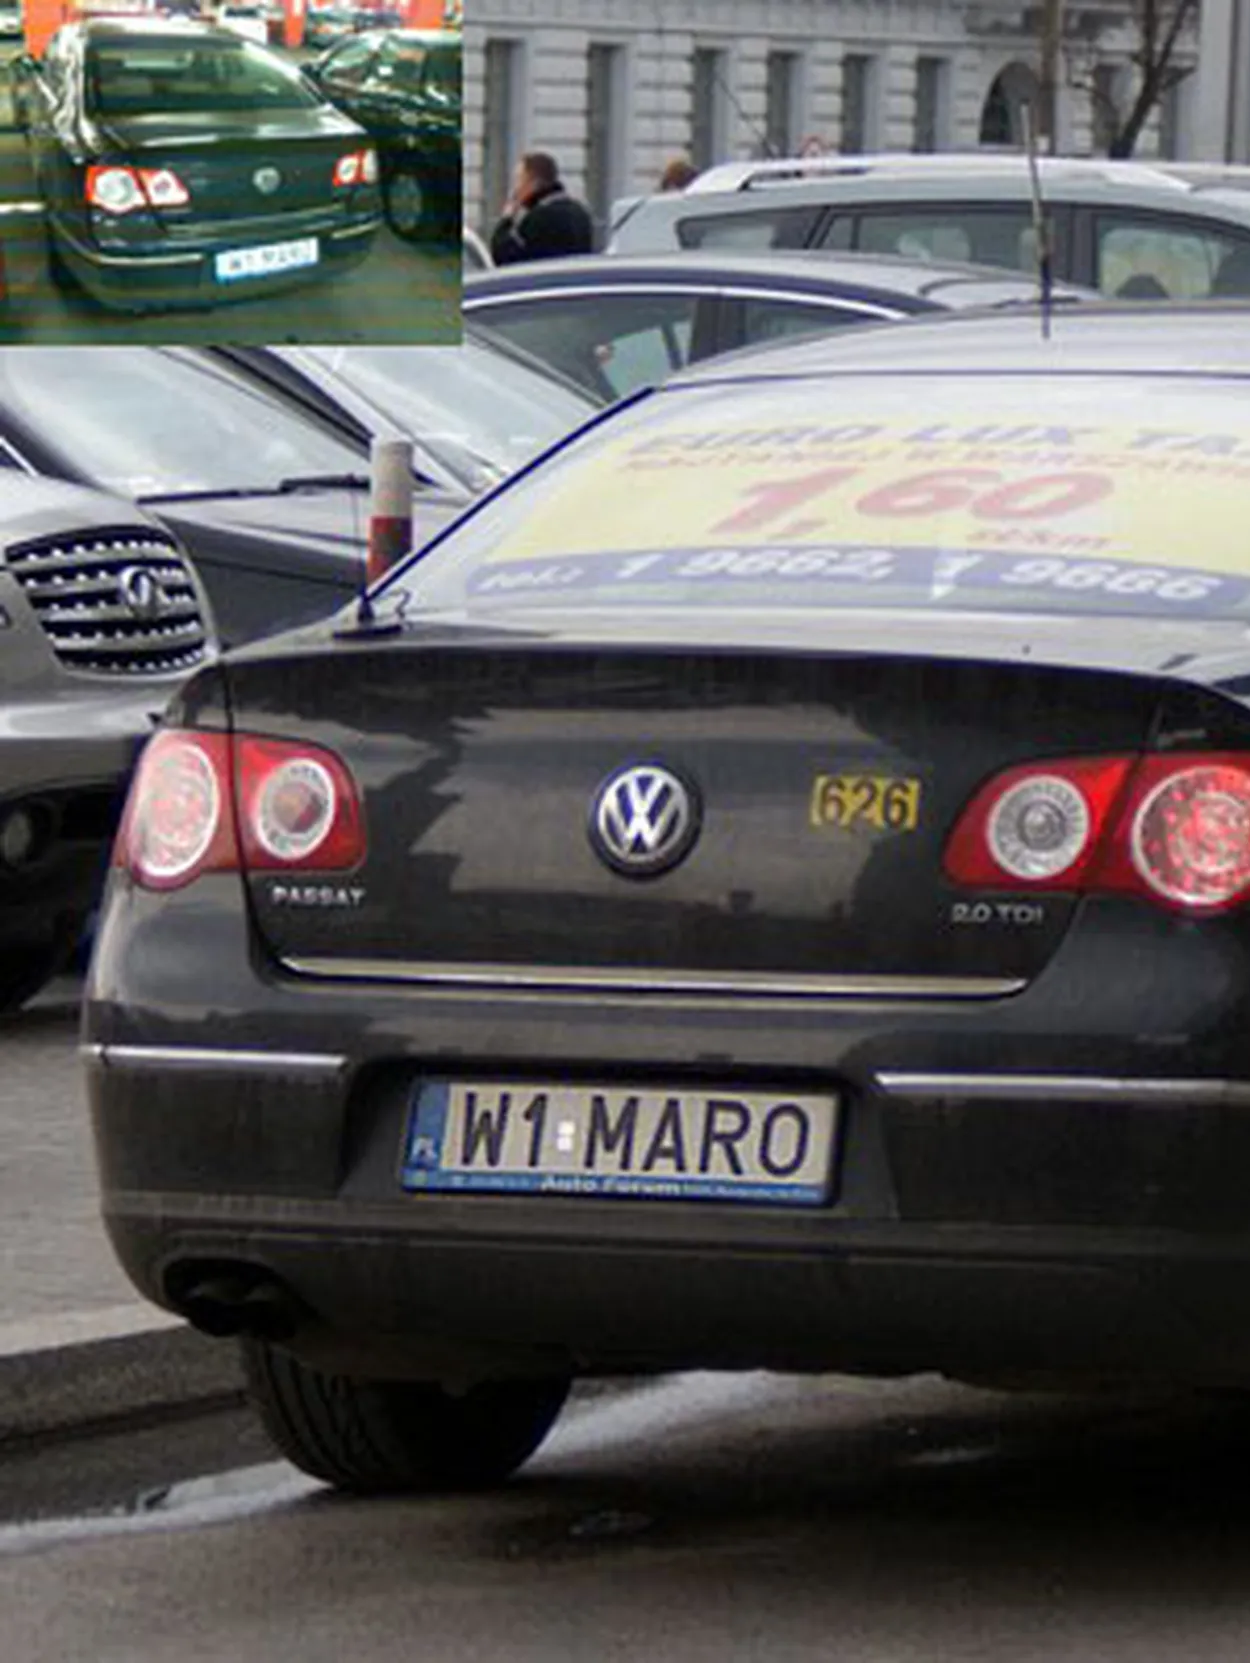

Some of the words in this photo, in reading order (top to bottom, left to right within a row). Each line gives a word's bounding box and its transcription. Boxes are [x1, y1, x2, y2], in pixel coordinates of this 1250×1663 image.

[629, 424, 886, 453] EURO
[902, 423, 1103, 445] LUX
[1001, 557, 1222, 600] 9666
[819, 778, 910, 825] 626
[271, 886, 366, 905] PASSAT
[460, 1092, 550, 1167] W1
[584, 1095, 810, 1177] MARO
[540, 1174, 598, 1192] Auto
[603, 1175, 681, 1196] Forum
